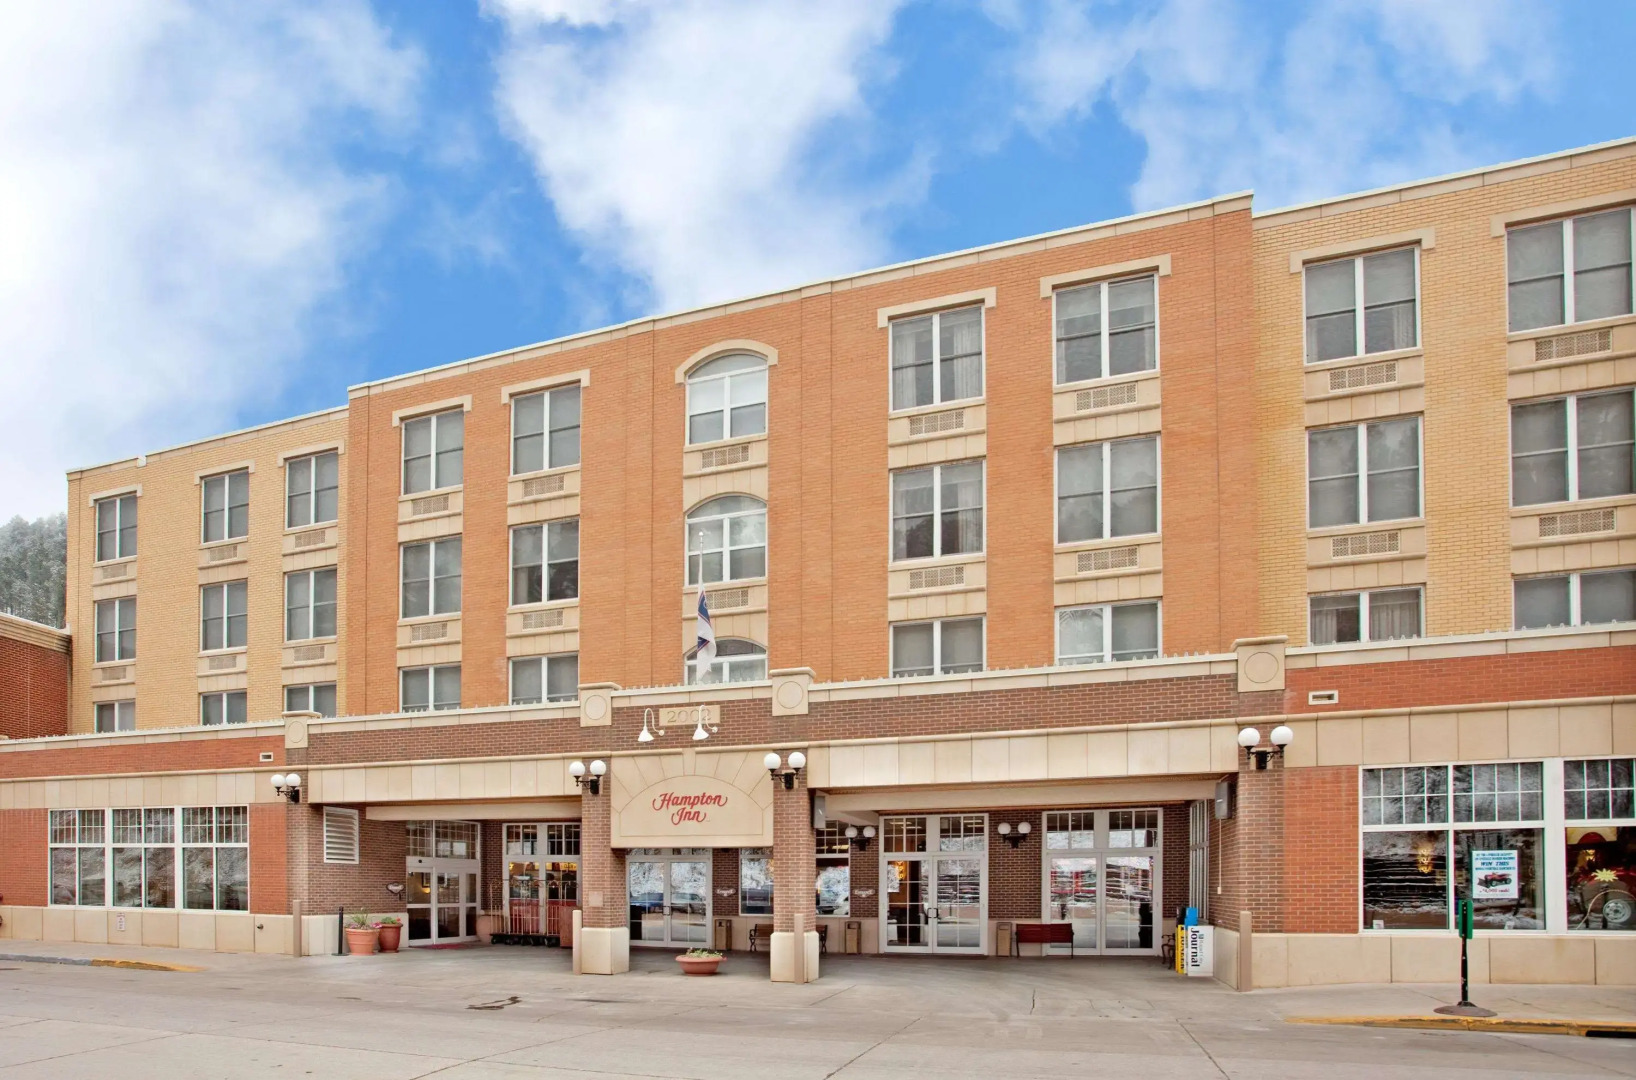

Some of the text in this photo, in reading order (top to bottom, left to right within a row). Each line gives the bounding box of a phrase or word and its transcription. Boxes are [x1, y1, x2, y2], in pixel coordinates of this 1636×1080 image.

[652, 792, 728, 811] Hampton
[671, 807, 707, 825] Inn
[1190, 927, 1201, 968] Journal
